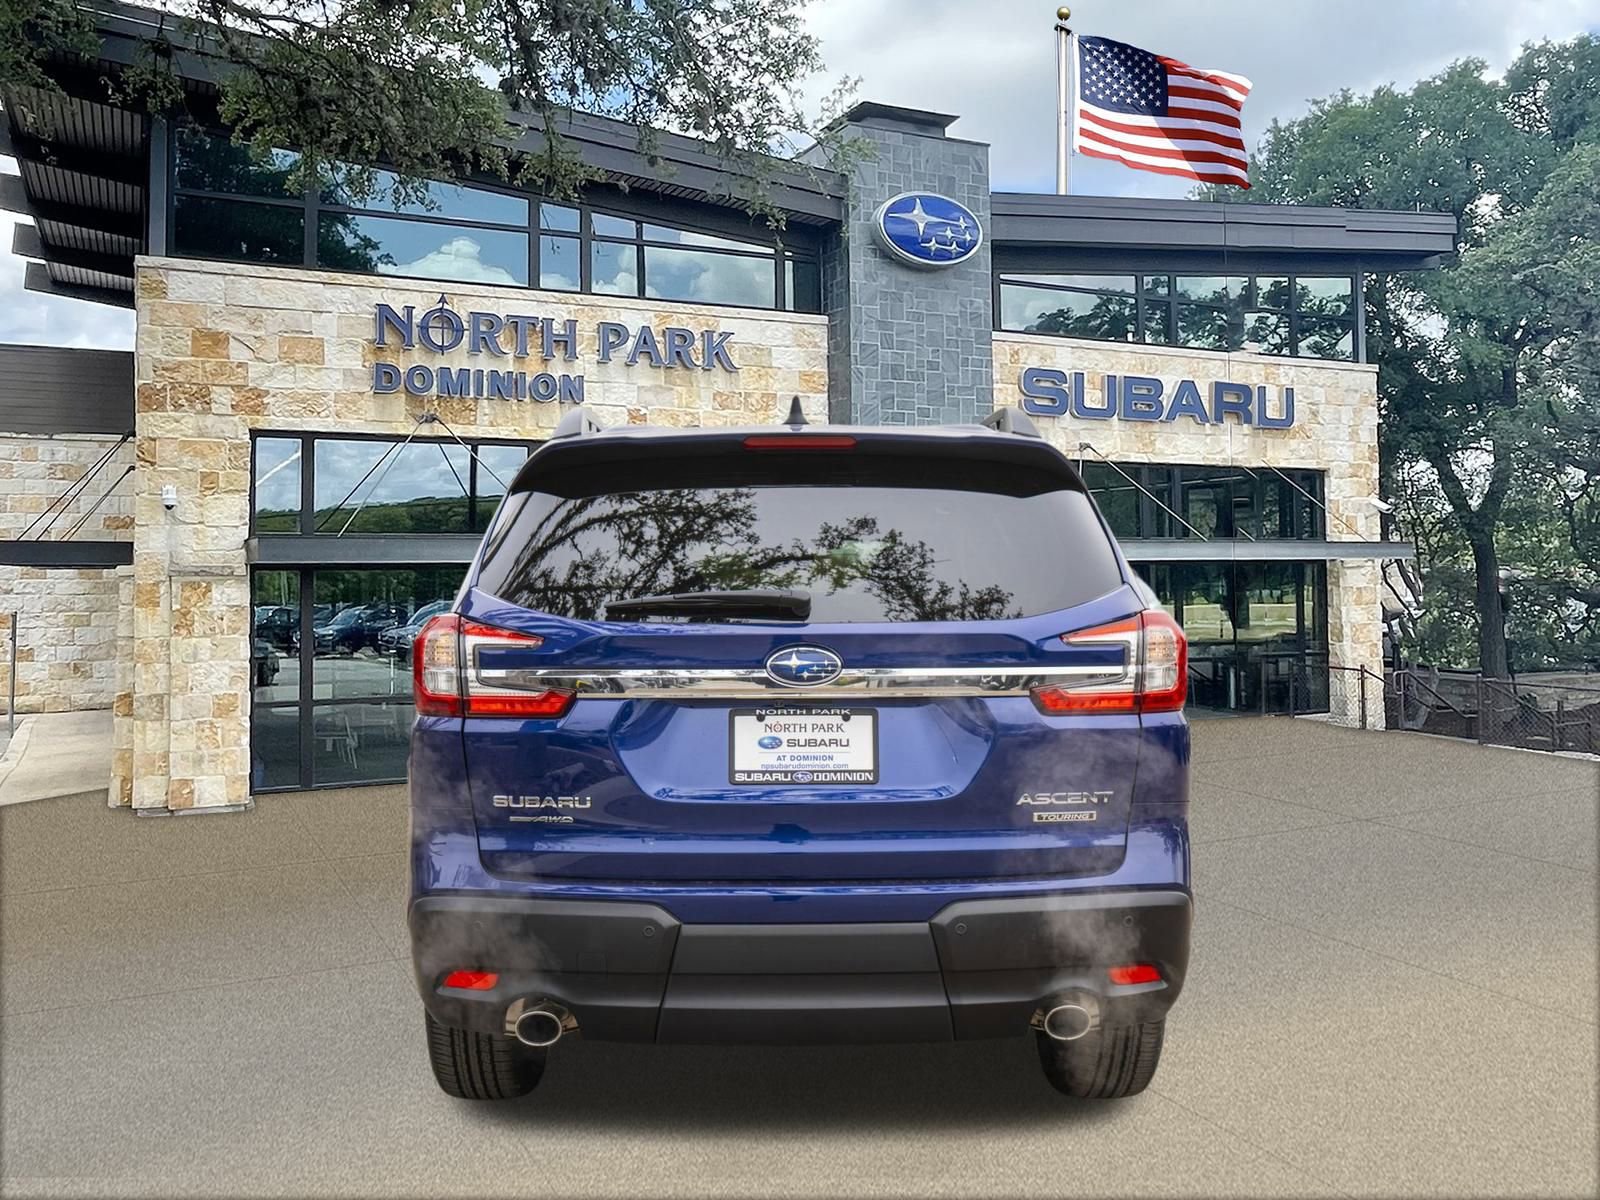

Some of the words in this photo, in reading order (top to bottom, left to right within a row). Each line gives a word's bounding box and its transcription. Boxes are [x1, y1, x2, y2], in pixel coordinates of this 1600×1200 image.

[374, 293, 579, 362] NORTH
[598, 321, 740, 372] PARK
[373, 362, 585, 403] DOMINION
[1019, 367, 1294, 429] SUBARU
[764, 721, 807, 733] NORTH
[811, 723, 845, 733] PARK
[786, 738, 849, 748] SUBARU
[761, 762, 849, 771] npsubarudominion.com
[735, 773, 791, 782] SUBARU
[813, 772, 873, 781] DOMINION
[493, 795, 591, 808] SUBARU
[1016, 791, 1114, 805] ASCENT
